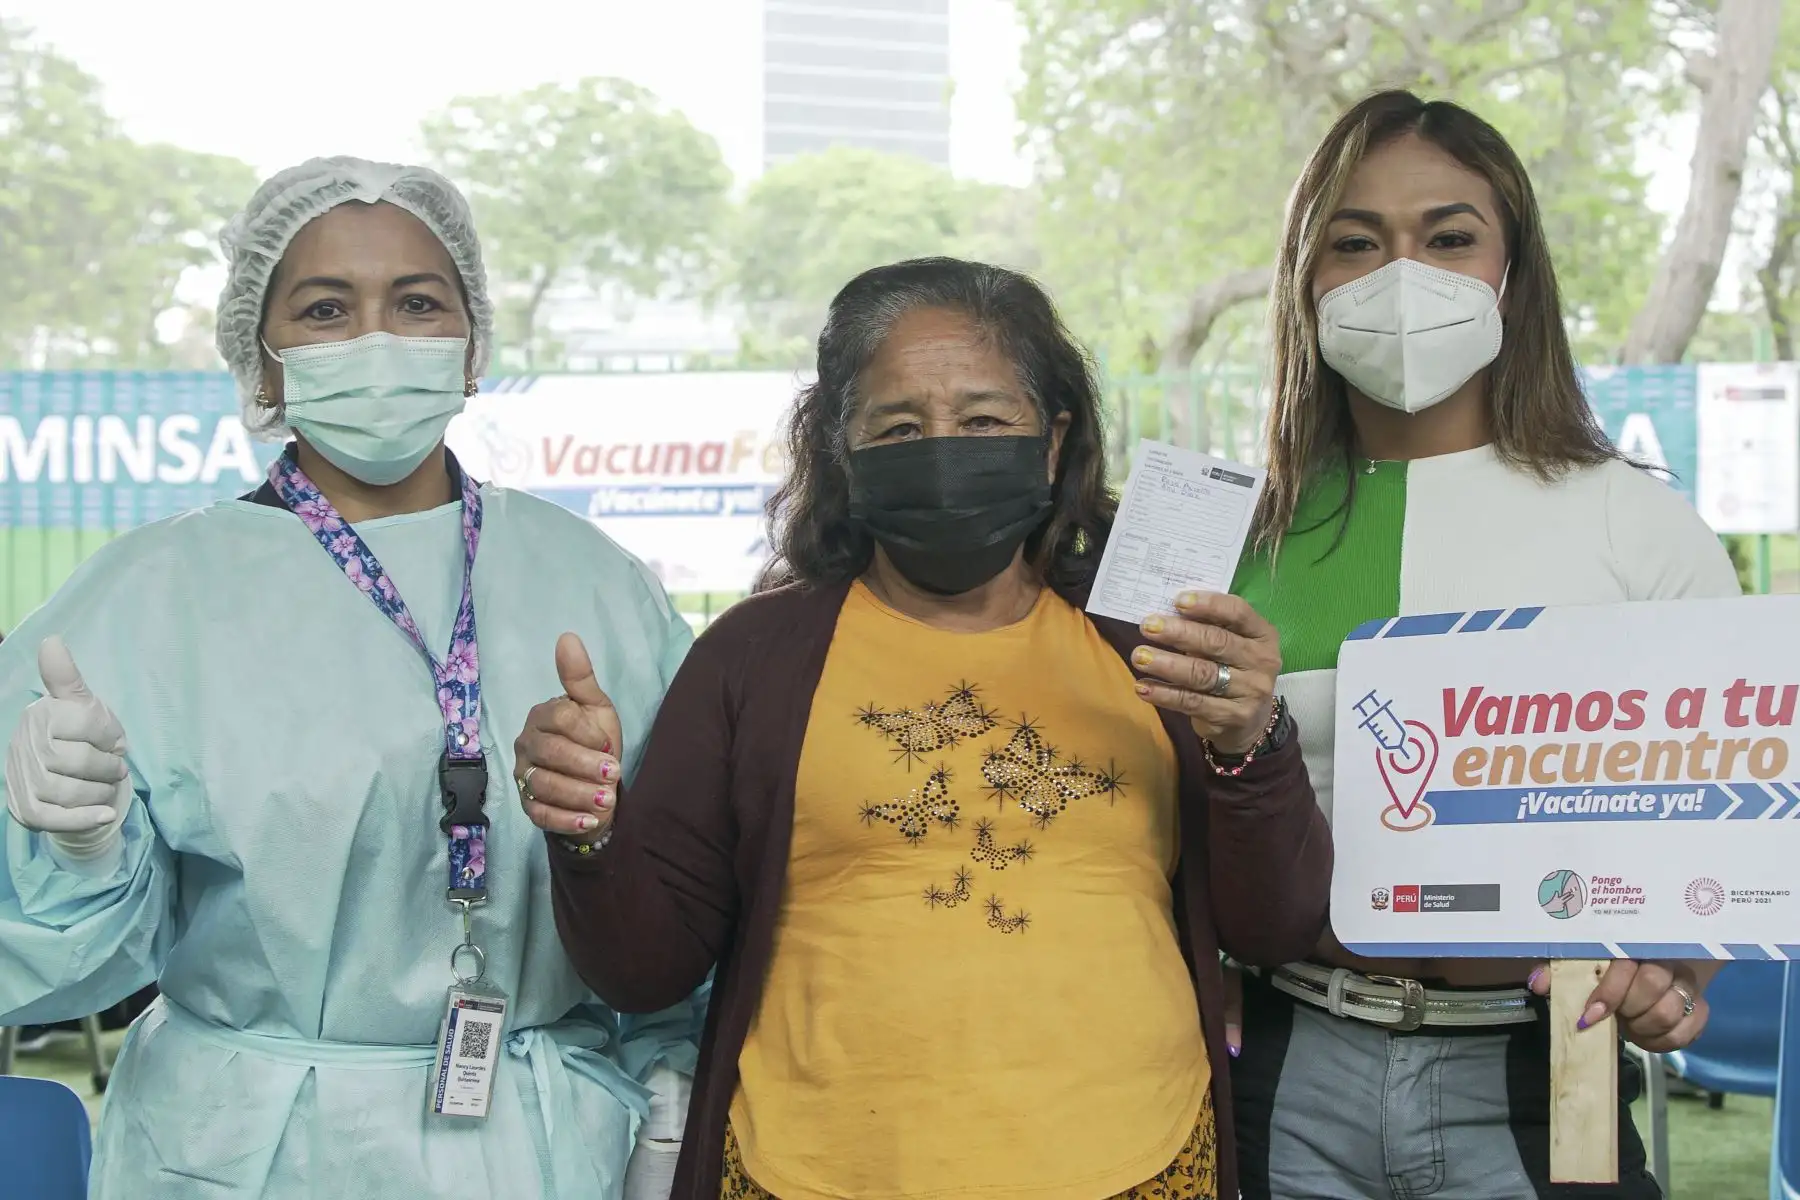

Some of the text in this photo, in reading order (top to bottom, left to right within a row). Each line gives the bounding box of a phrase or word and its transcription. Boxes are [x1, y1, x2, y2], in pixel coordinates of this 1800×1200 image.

[0, 415, 261, 484] MINSA
[1442, 678, 1800, 738] Vamos a tu
[1452, 731, 1789, 787] encuentro
[1517, 788, 1706, 819] ¡Vacúnate ya!
[1591, 875, 1622, 887] Pongo
[1591, 886, 1642, 895] el hombro
[1396, 893, 1417, 903] PERÚ
[1590, 895, 1645, 907] por el Perú
[436, 1028, 454, 1109] PERSONAL DE SALUD
